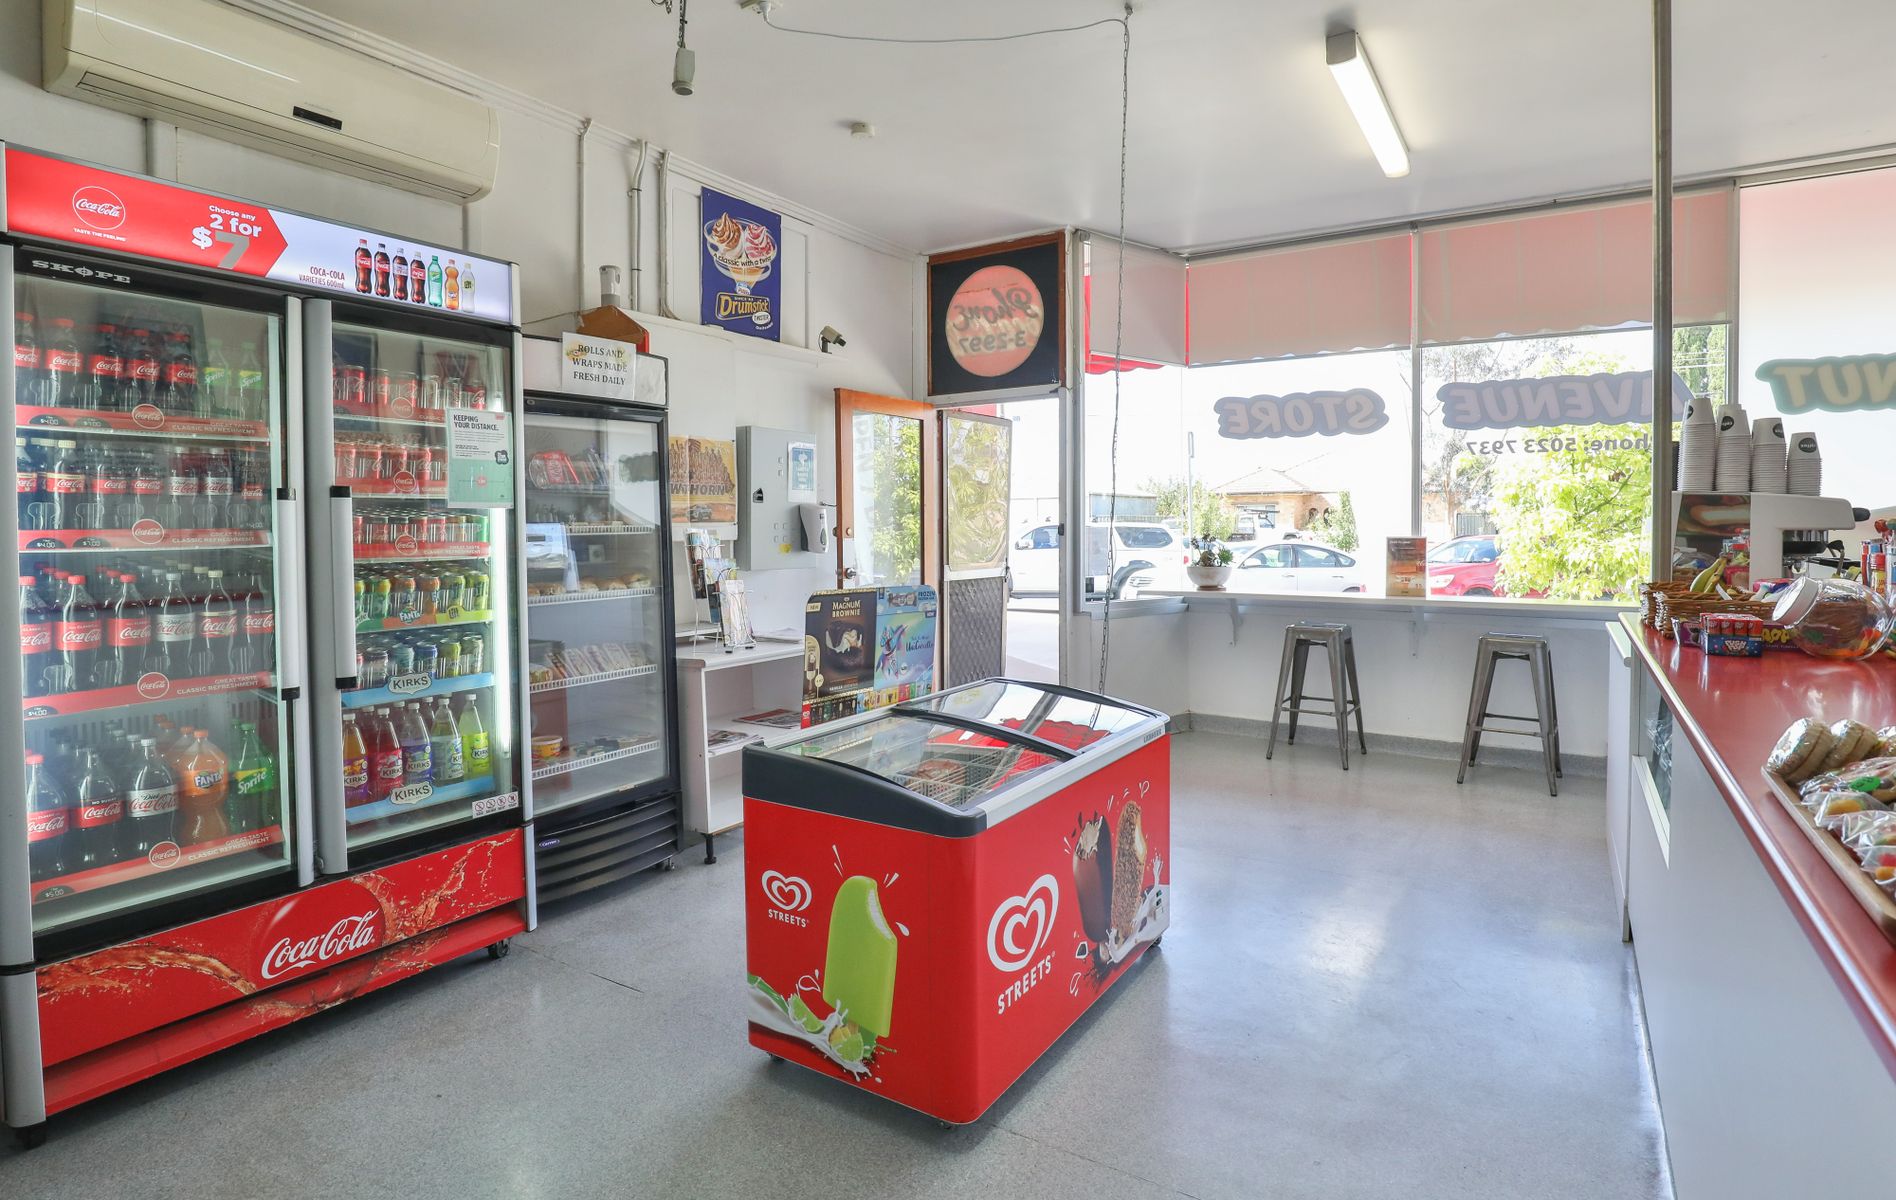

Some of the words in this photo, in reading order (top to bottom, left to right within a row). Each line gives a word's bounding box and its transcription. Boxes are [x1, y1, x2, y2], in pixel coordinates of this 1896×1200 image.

[75, 198, 123, 218] Coca-Cola
[208, 205, 240, 219] Choose
[240, 213, 256, 222] any
[209, 213, 223, 230] 2
[229, 216, 262, 238] for
[73, 228, 91, 236] TASTE
[103, 233, 126, 241] FEELING
[718, 255, 739, 266] classic
[741, 258, 754, 266] with
[759, 256, 771, 264] twist
[31, 259, 131, 284] SKOPE
[310, 266, 345, 281] COCA-COLA
[299, 273, 326, 287] VARIETIES
[720, 295, 769, 316] Drumstick
[578, 344, 605, 356] ROLLS
[606, 348, 625, 359] AND
[572, 358, 603, 369] WRAPS
[604, 361, 628, 373] MADE
[573, 371, 600, 382] FRESH
[602, 375, 626, 386] DAILY
[453, 414, 479, 423] KEEPING
[454, 421, 470, 429] YOUR
[471, 422, 499, 431] DISTANCE.
[172, 423, 203, 432] CLASSIC
[203, 536, 255, 544] REFRESHMENT
[832, 600, 861, 611] MAGNUM
[832, 608, 860, 618] BROWNIE
[176, 686, 207, 695] CLASSIC
[207, 680, 259, 692] REFRESHMENT
[393, 675, 429, 690] KIRKS
[408, 761, 431, 771] KIRKS
[194, 770, 223, 787] FANTA
[237, 771, 268, 794] Sprite
[344, 774, 368, 786] KIRKS
[394, 784, 431, 801] KIRKS
[188, 850, 219, 861] CLASSIC
[219, 837, 270, 854] REFRESHMENT
[768, 908, 807, 928] STREETS
[261, 909, 380, 980] Coca-Cola
[997, 957, 1052, 1015] STREETS
